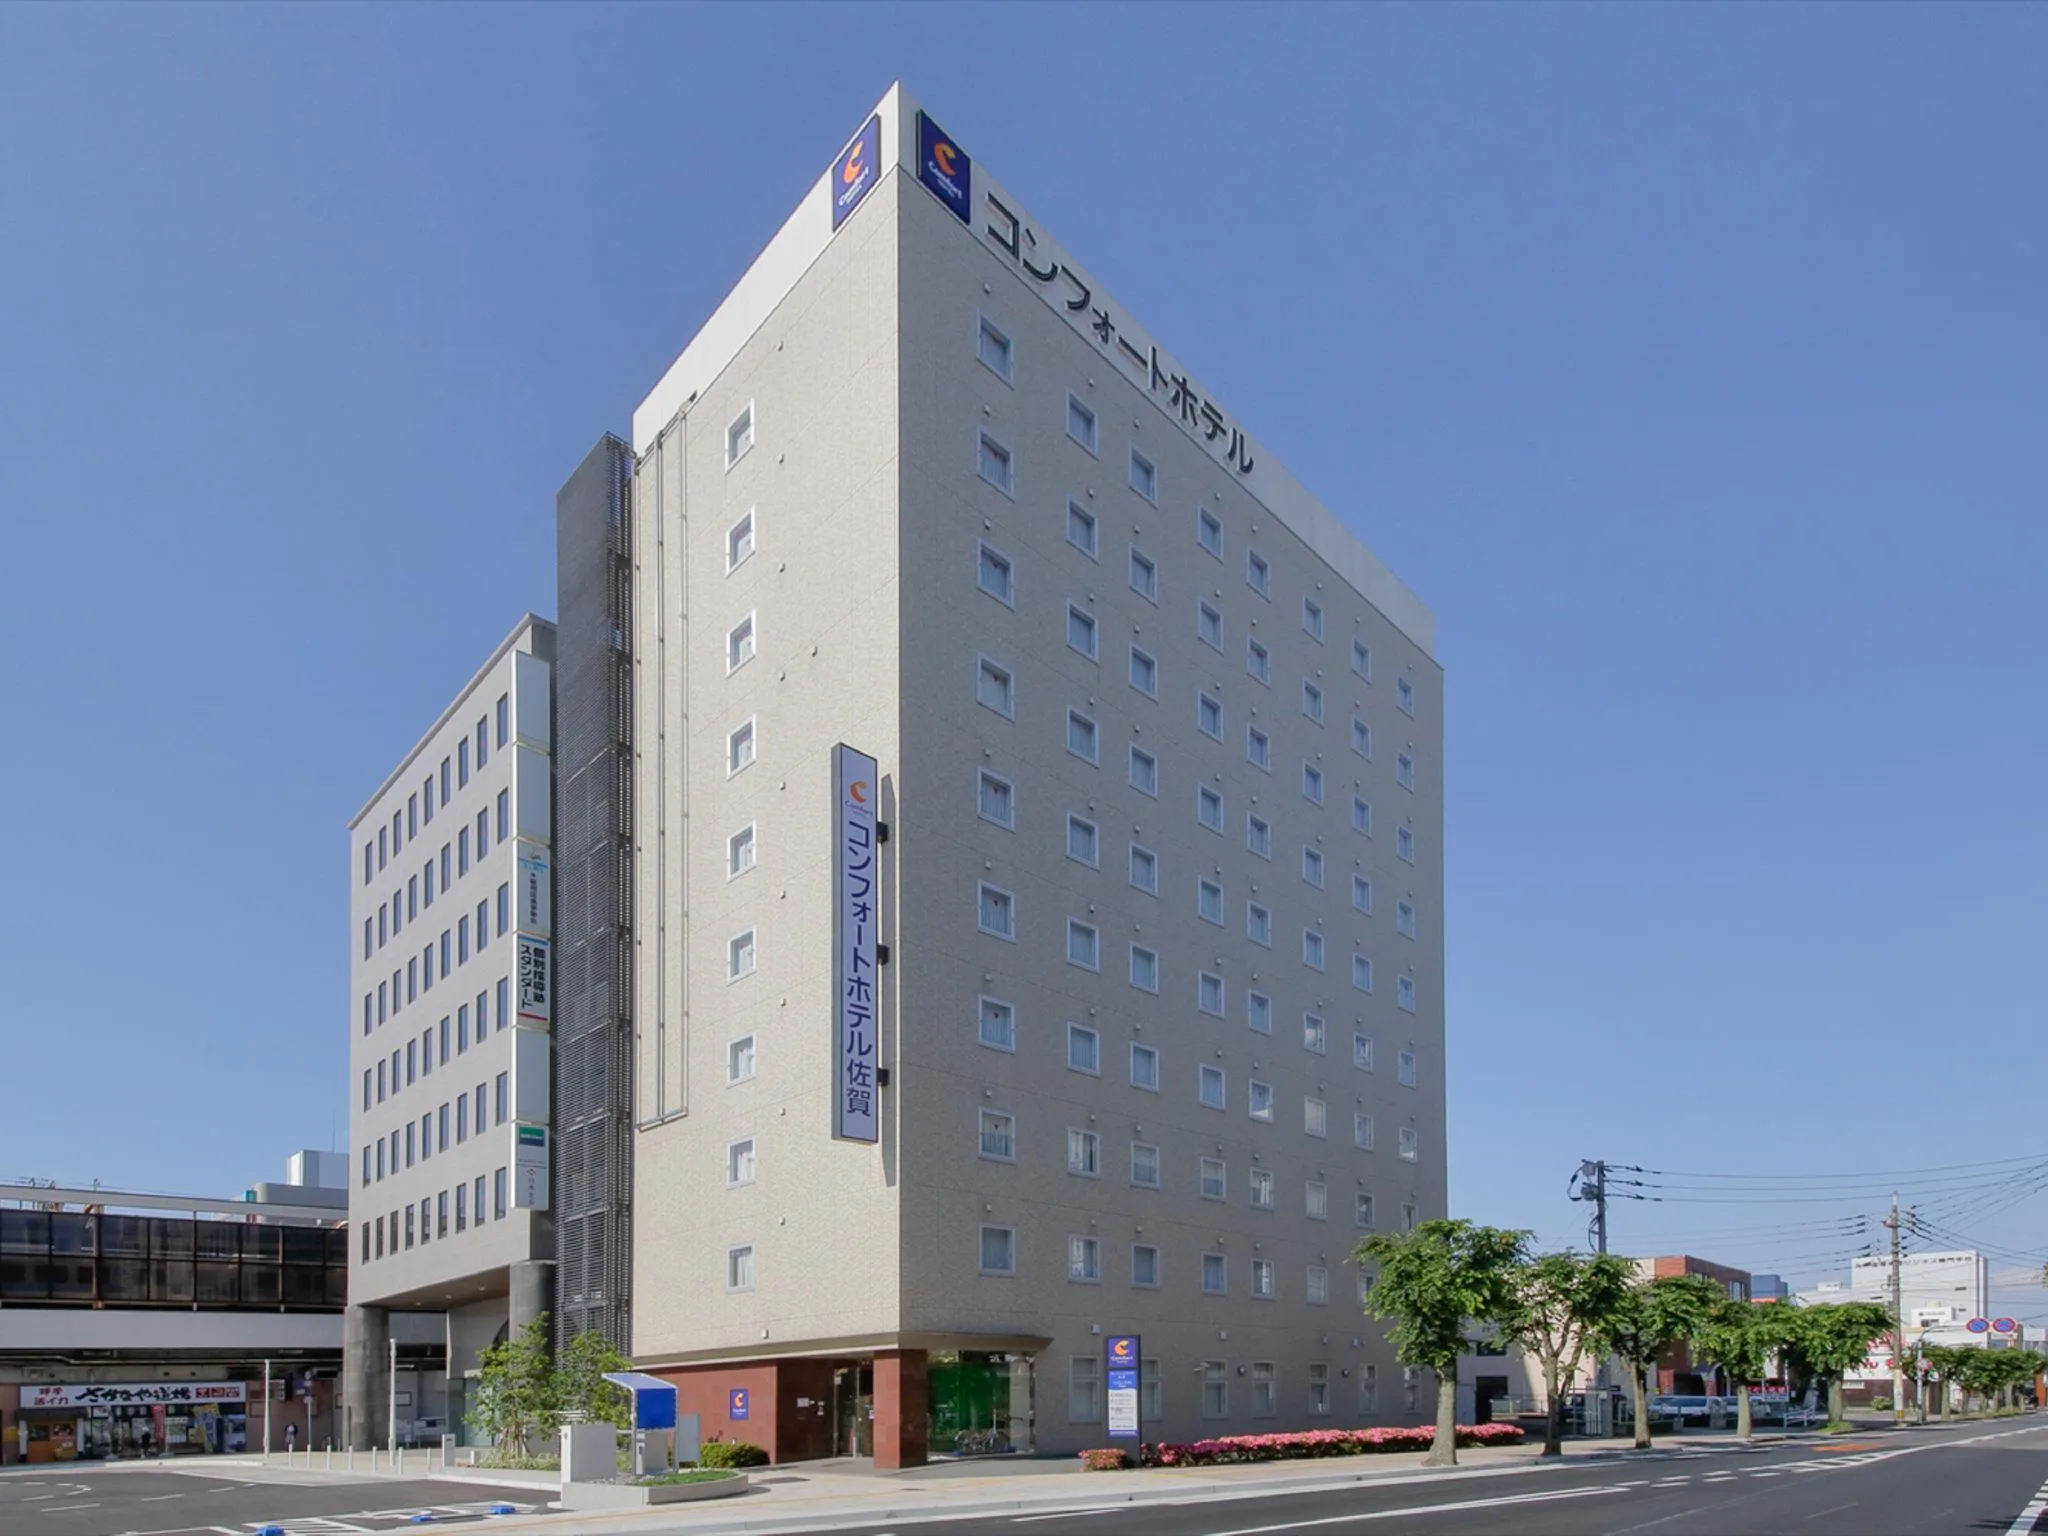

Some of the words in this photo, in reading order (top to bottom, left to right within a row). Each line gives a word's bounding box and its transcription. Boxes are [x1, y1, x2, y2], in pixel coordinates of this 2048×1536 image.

[984, 191, 1254, 475] コンフォートホテル
[846, 819, 872, 1117] コンフォートホテル佐賀
